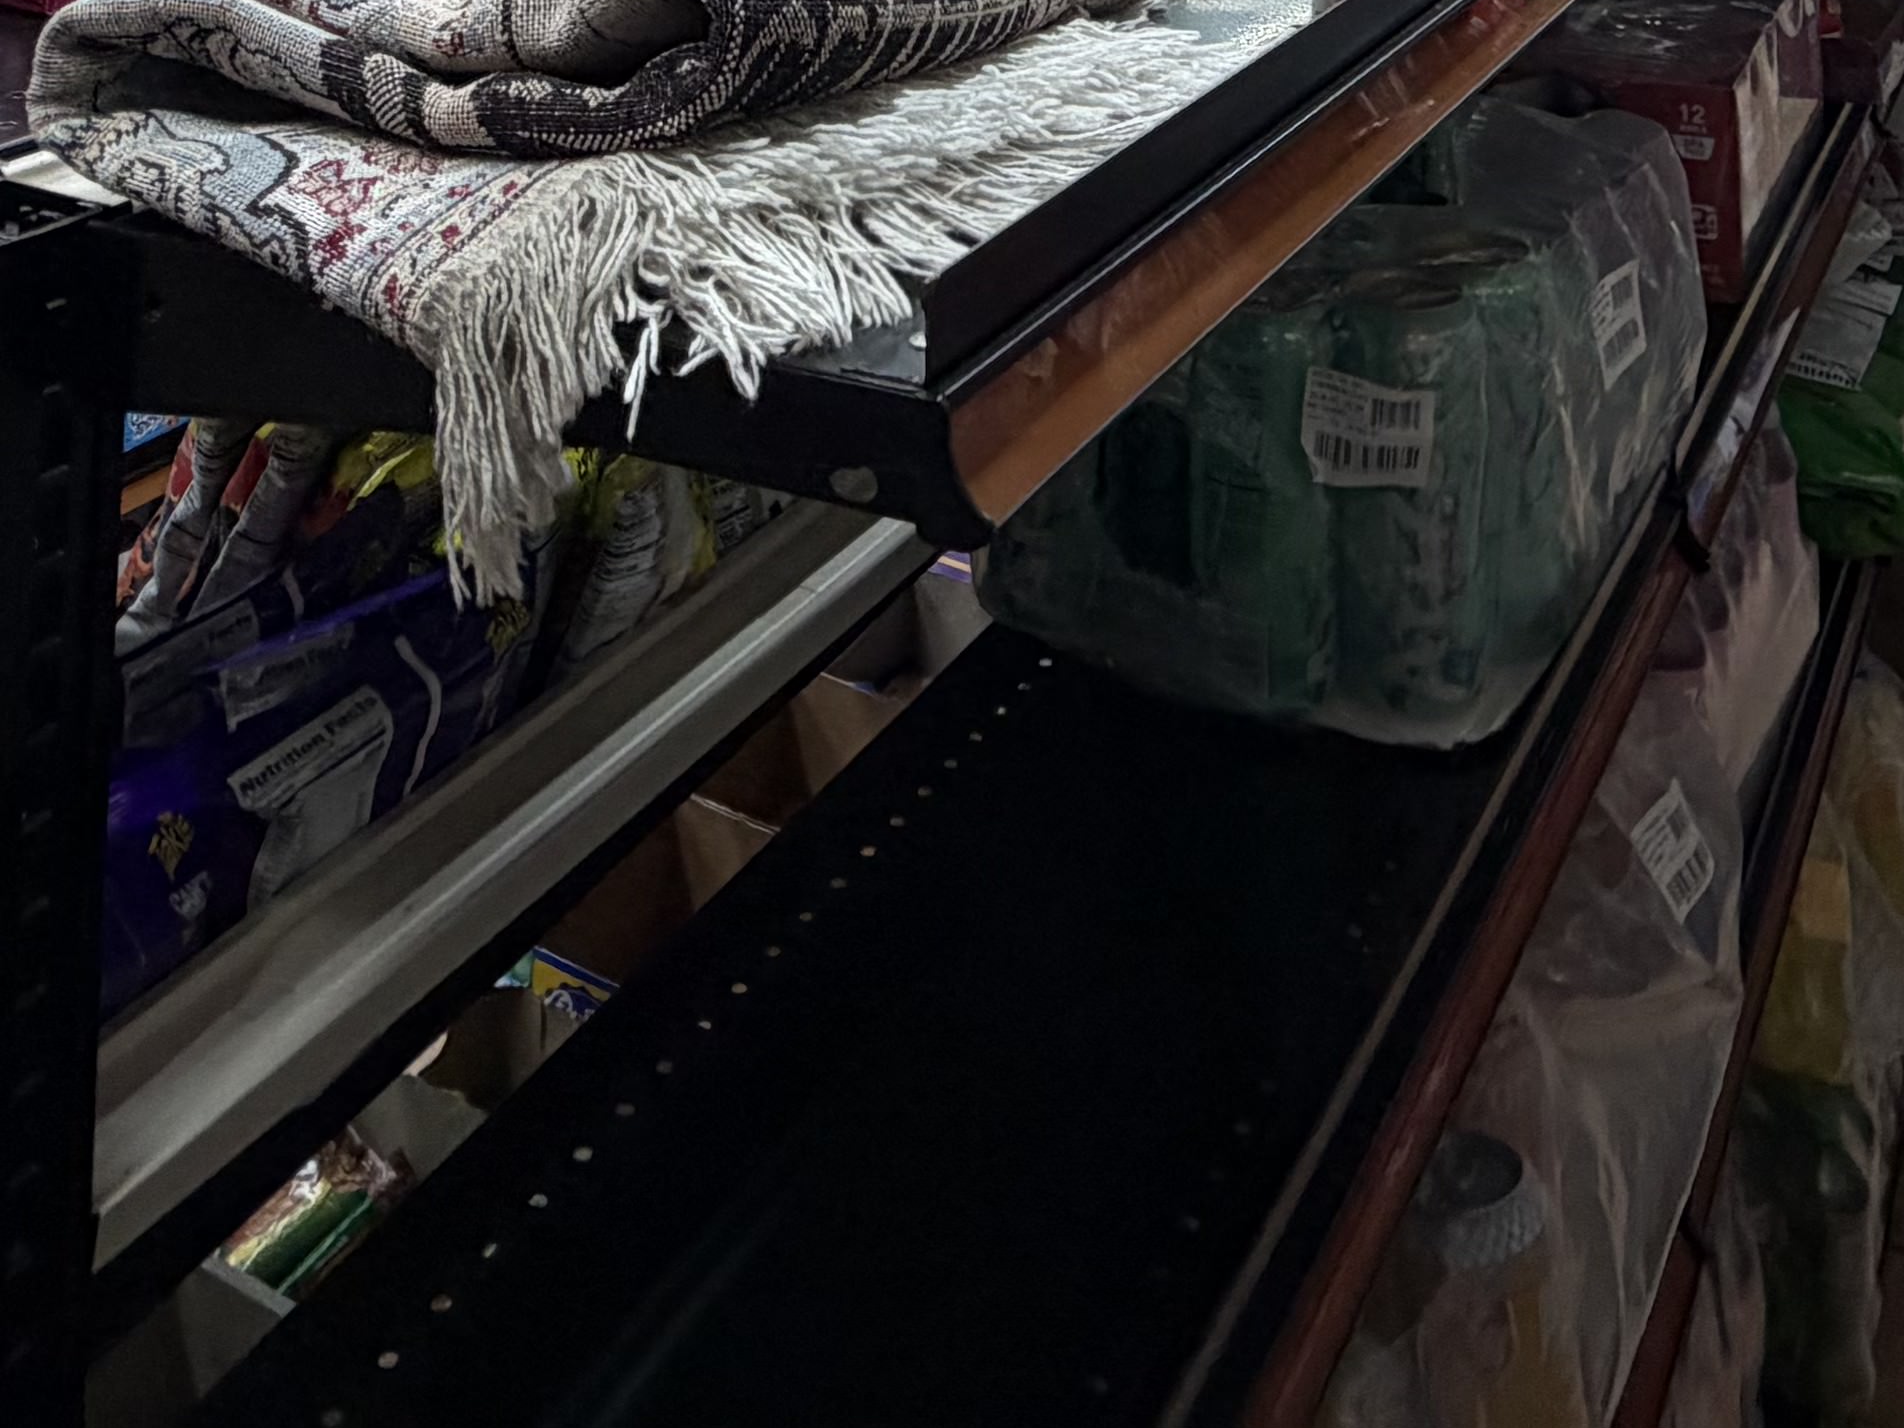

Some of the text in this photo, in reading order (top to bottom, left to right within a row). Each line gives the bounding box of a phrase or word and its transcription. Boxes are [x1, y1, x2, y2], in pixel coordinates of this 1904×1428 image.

[1679, 104, 1705, 126] 12
[237, 696, 379, 796] Nutrition Facts
